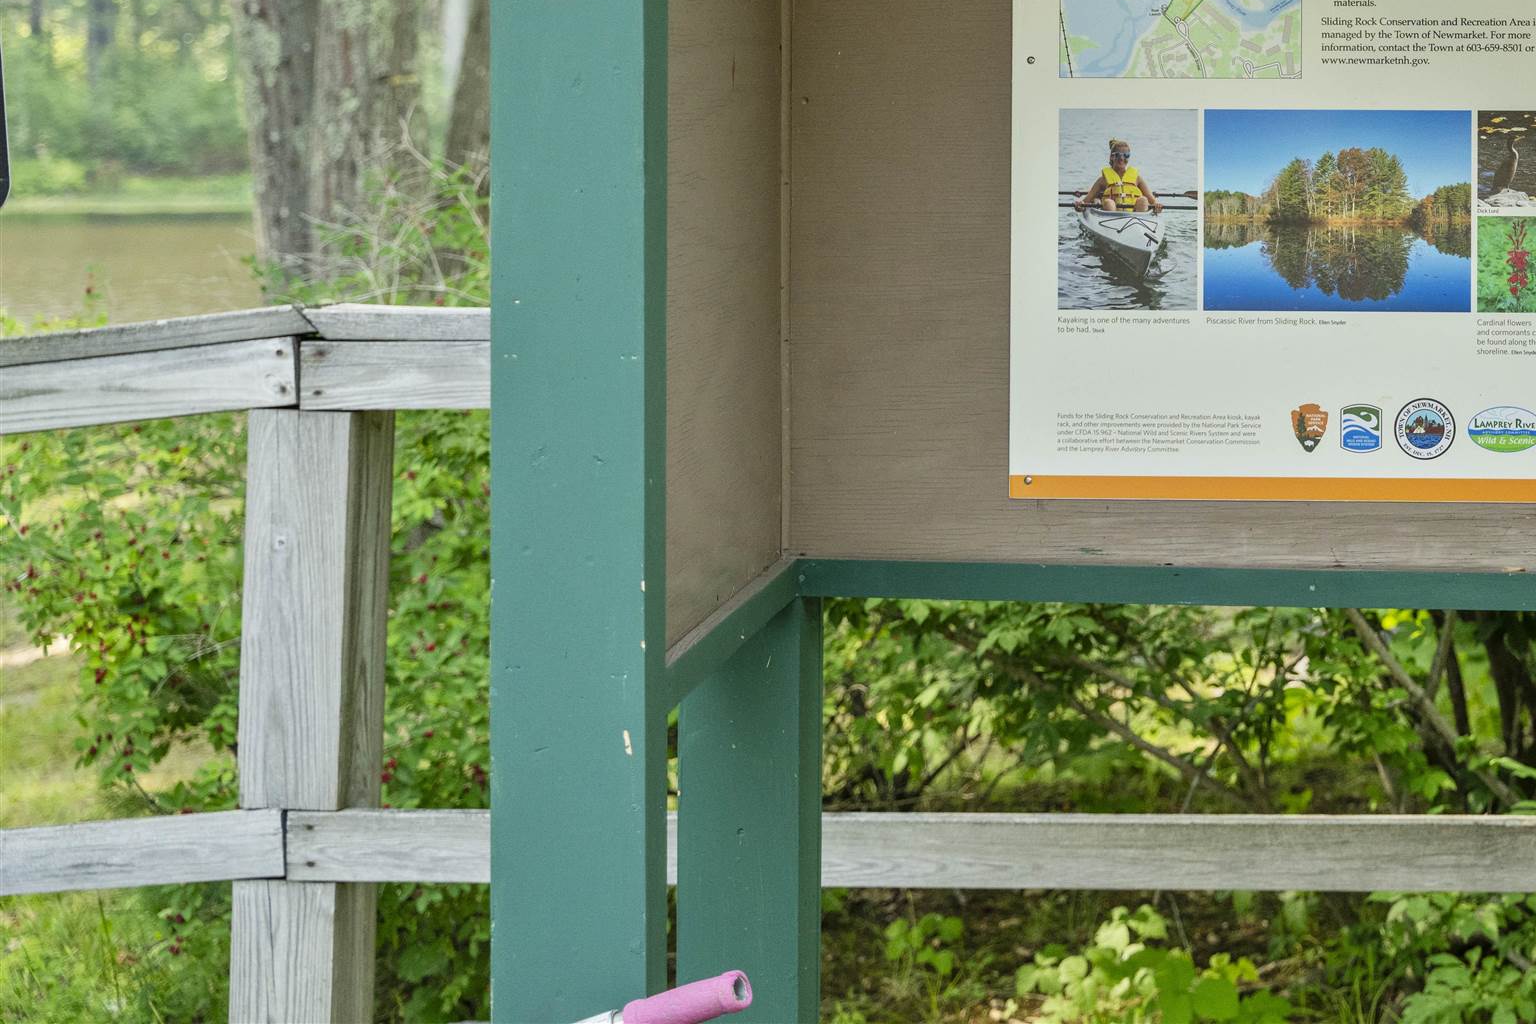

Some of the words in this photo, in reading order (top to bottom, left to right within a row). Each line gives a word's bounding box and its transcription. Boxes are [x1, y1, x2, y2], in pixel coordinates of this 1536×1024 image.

[1321, 43, 1376, 52] information,
[1378, 44, 1410, 52] contact
[1412, 43, 1427, 52] the
[1428, 43, 1454, 52] Town
[1455, 44, 1464, 52] at
[1466, 43, 1522, 53] 603-659-8501
[1057, 316, 1089, 326] Kayaking
[1110, 316, 1118, 324] of
[1152, 317, 1190, 325] adventures
[1206, 316, 1237, 325] Piscassic
[1257, 317, 1274, 325] from
[1274, 317, 1298, 326] Sliding
[1299, 317, 1317, 327] Rock.
[1476, 318, 1506, 328] Cardinal
[1507, 319, 1532, 327] flowers
[1478, 436, 1496, 445] Wild
[1499, 436, 1506, 445] &
[1509, 436, 1536, 445] Scenic
